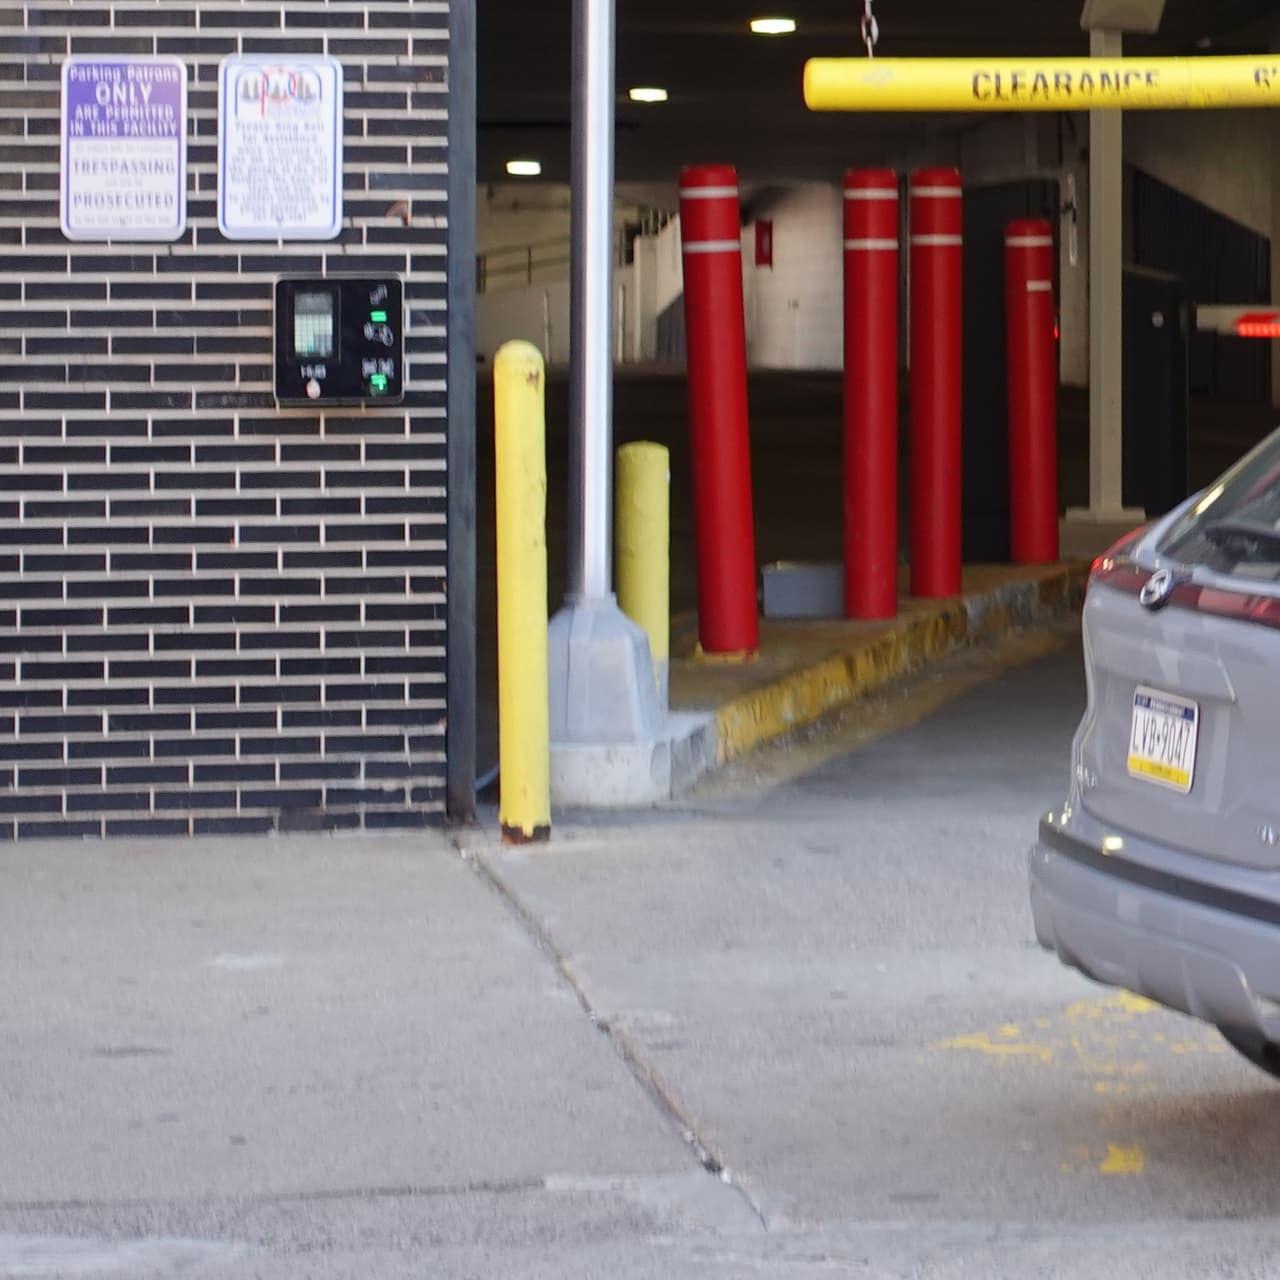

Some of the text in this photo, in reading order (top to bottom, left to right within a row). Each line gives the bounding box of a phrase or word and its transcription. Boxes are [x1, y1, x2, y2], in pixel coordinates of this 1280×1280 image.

[70, 64, 179, 82] Parking Patrons
[95, 81, 152, 107] ONLY
[971, 69, 1160, 101] CLEARANCE
[75, 103, 174, 121] ARE PERMITTED
[70, 120, 177, 136] IN THIS FACILITY
[73, 159, 175, 176] TRESPASSING
[73, 191, 173, 208] PROSECUTED
